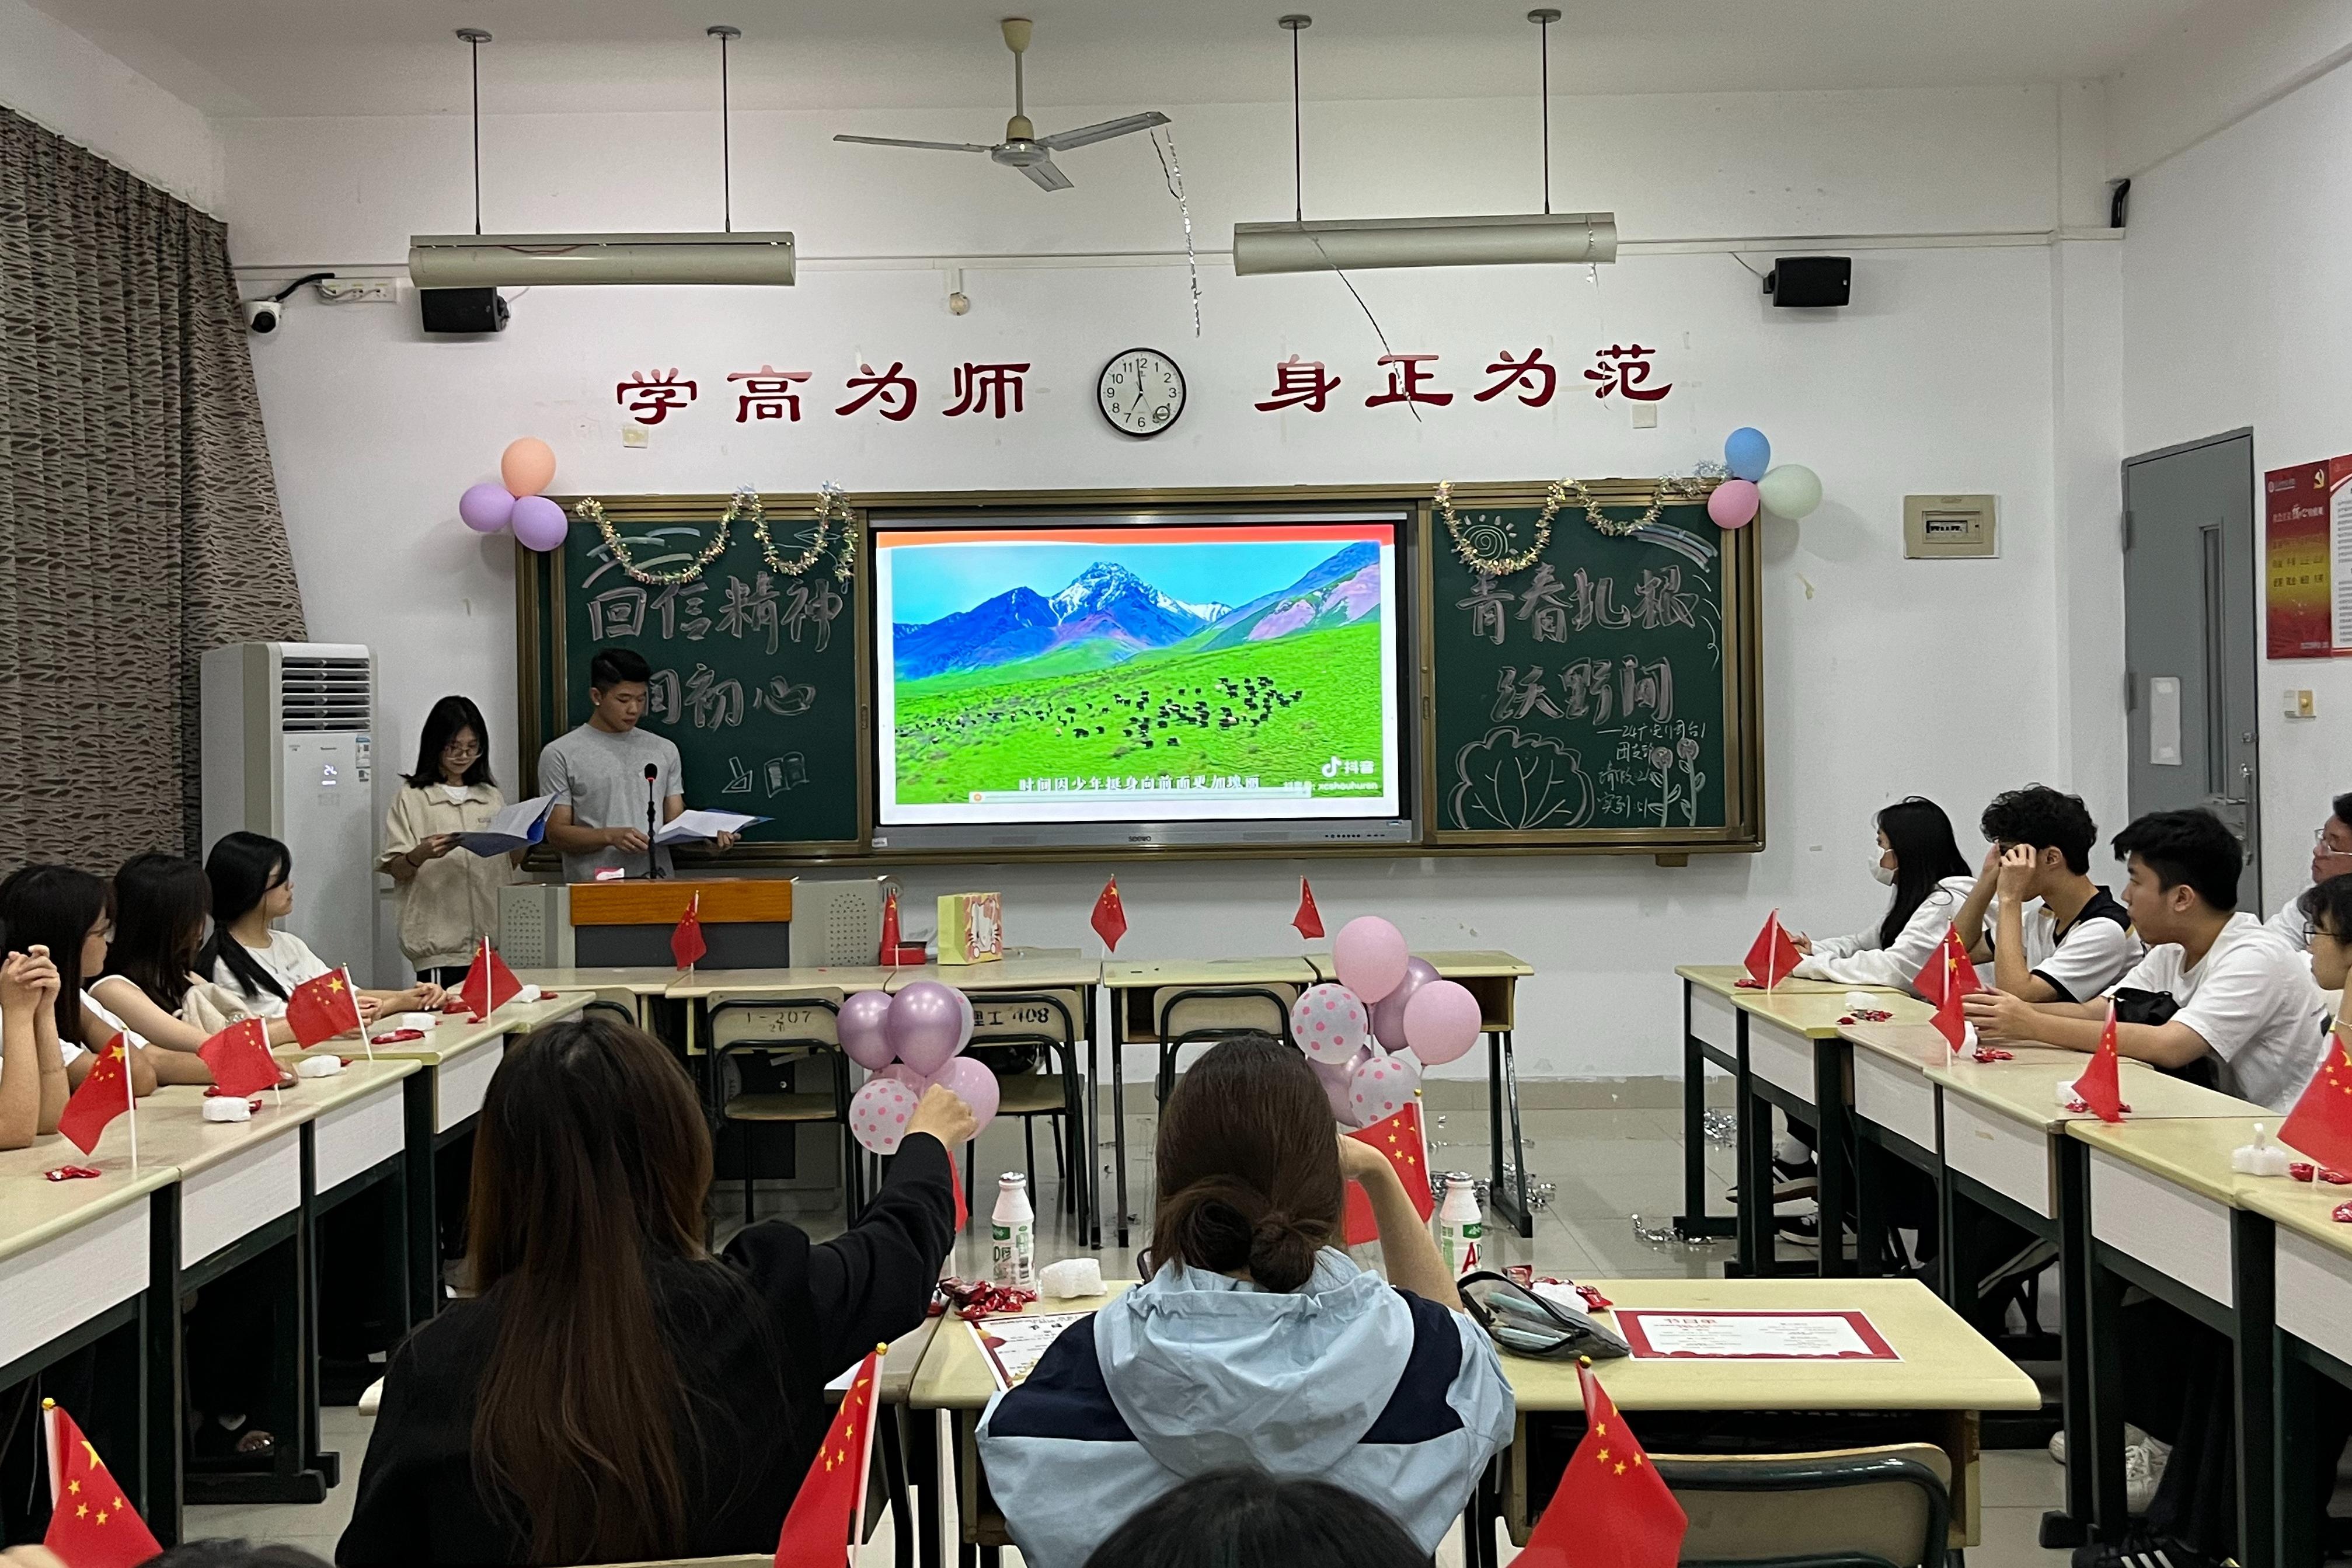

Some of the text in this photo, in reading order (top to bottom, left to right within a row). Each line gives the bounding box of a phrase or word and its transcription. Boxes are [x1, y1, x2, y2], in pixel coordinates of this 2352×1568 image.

[1123, 363, 1133, 372] 11
[1136, 358, 1148, 368] 12
[1155, 362, 1159, 372] 1
[1112, 374, 1124, 384] 10
[1163, 372, 1172, 383] 2
[1253, 344, 1673, 413] 身正为范
[616, 361, 1031, 425] 学高为师
[1107, 388, 1115, 398] 9
[1168, 388, 1177, 398] 3
[1112, 402, 1120, 413] 8
[1124, 413, 1131, 423] 7
[1138, 417, 1146, 427] 6
[1456, 562, 1699, 644] 青春扎根
[587, 570, 844, 655] 回信精神
[1490, 654, 1674, 725] 沃野间
[1344, 761, 1374, 774] 抖音
